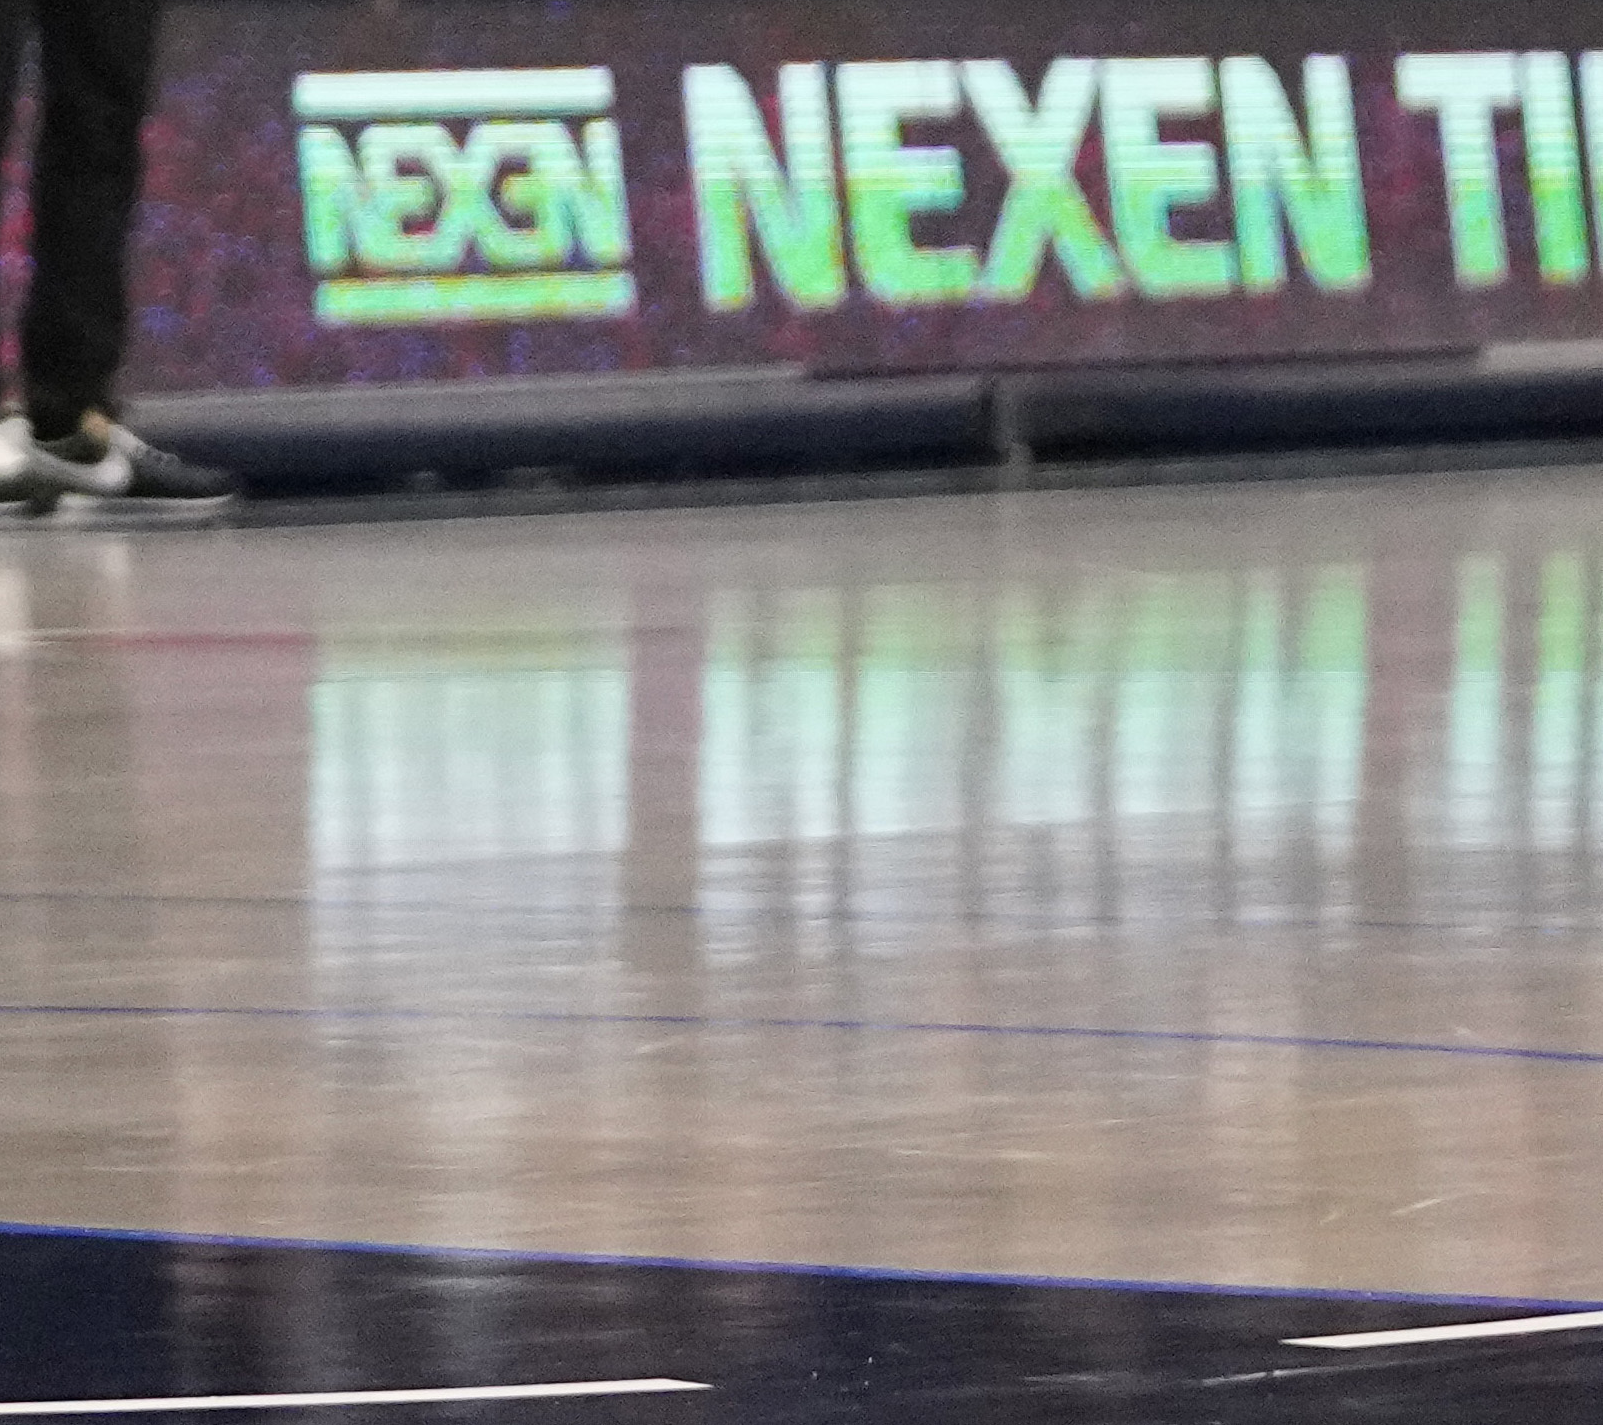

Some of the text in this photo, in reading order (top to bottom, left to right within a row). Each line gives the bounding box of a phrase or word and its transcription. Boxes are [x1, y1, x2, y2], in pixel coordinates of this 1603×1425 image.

[298, 119, 633, 276] NEXEN
[682, 51, 1603, 315] NEXEN TI
